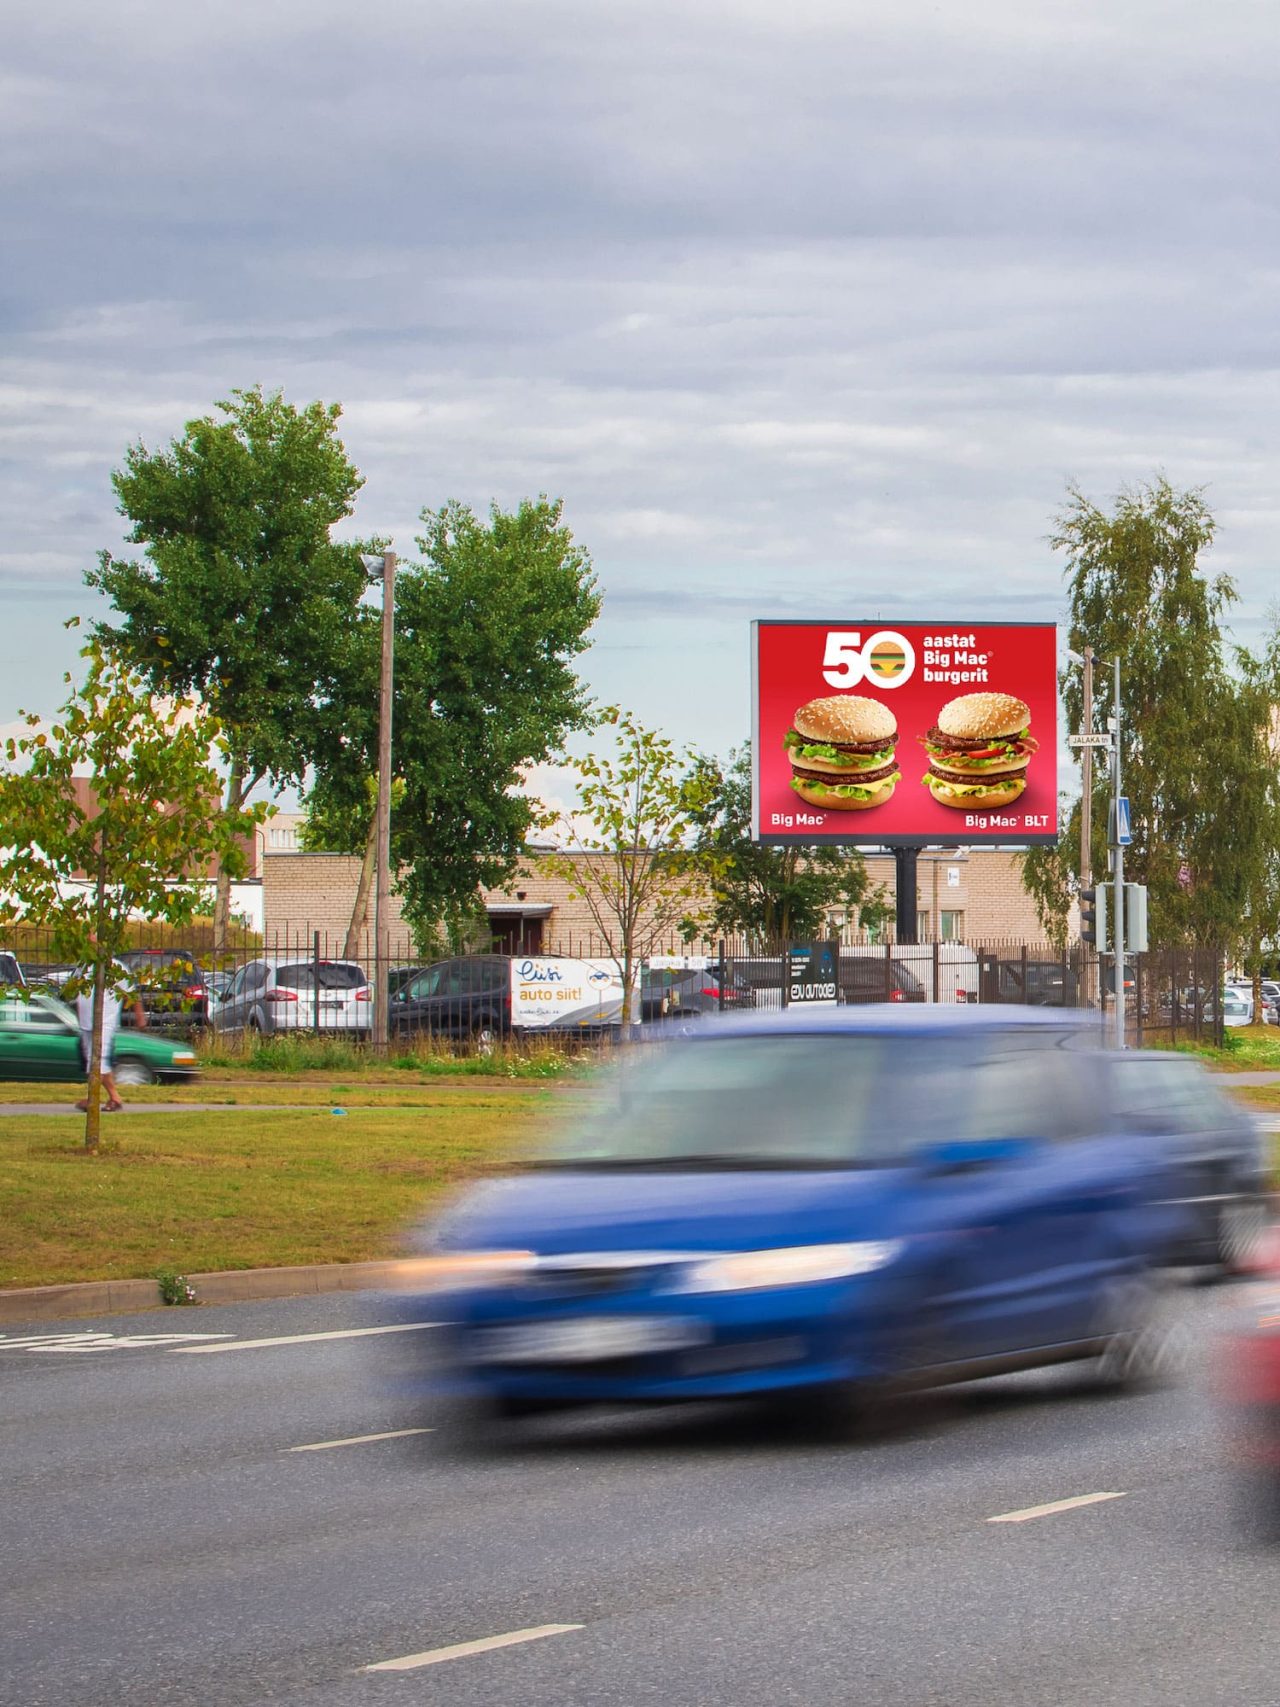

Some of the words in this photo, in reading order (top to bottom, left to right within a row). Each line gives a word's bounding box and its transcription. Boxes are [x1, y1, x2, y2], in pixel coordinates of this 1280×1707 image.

[922, 633, 976, 648] aastat
[822, 630, 916, 689] 50
[923, 651, 951, 668] Big
[923, 668, 989, 685] burgerit
[1073, 736, 1100, 744] JALAKA
[771, 813, 793, 827] Big
[965, 815, 987, 829] Big
[1024, 815, 1049, 827] BLT
[519, 989, 553, 1001] auto
[556, 987, 582, 1001] siit!
